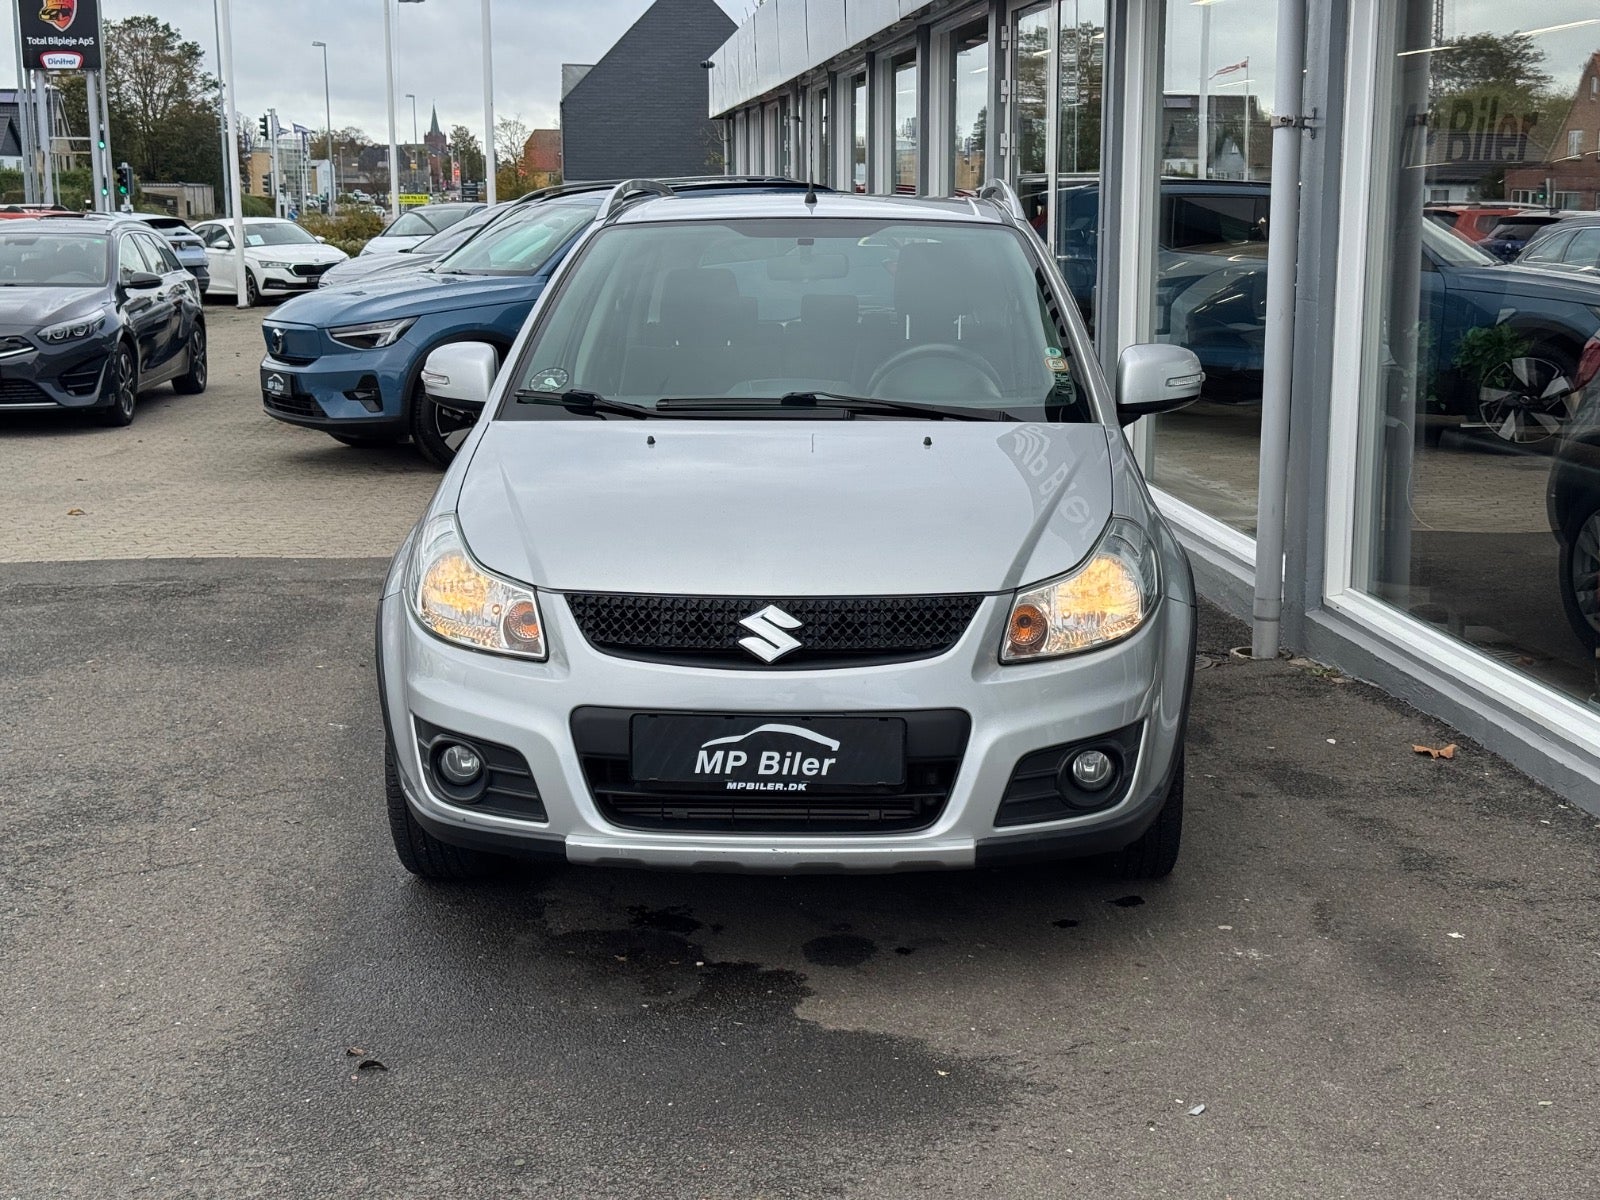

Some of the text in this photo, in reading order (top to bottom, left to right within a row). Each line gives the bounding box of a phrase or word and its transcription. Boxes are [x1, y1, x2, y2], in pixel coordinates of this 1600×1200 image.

[27, 36, 94, 47] Total Bilpleje ApS
[47, 57, 76, 65] Dinitrol
[1445, 95, 1539, 161] Biler
[694, 750, 836, 776] MP Biler
[726, 781, 807, 791] MPBILER.DK
